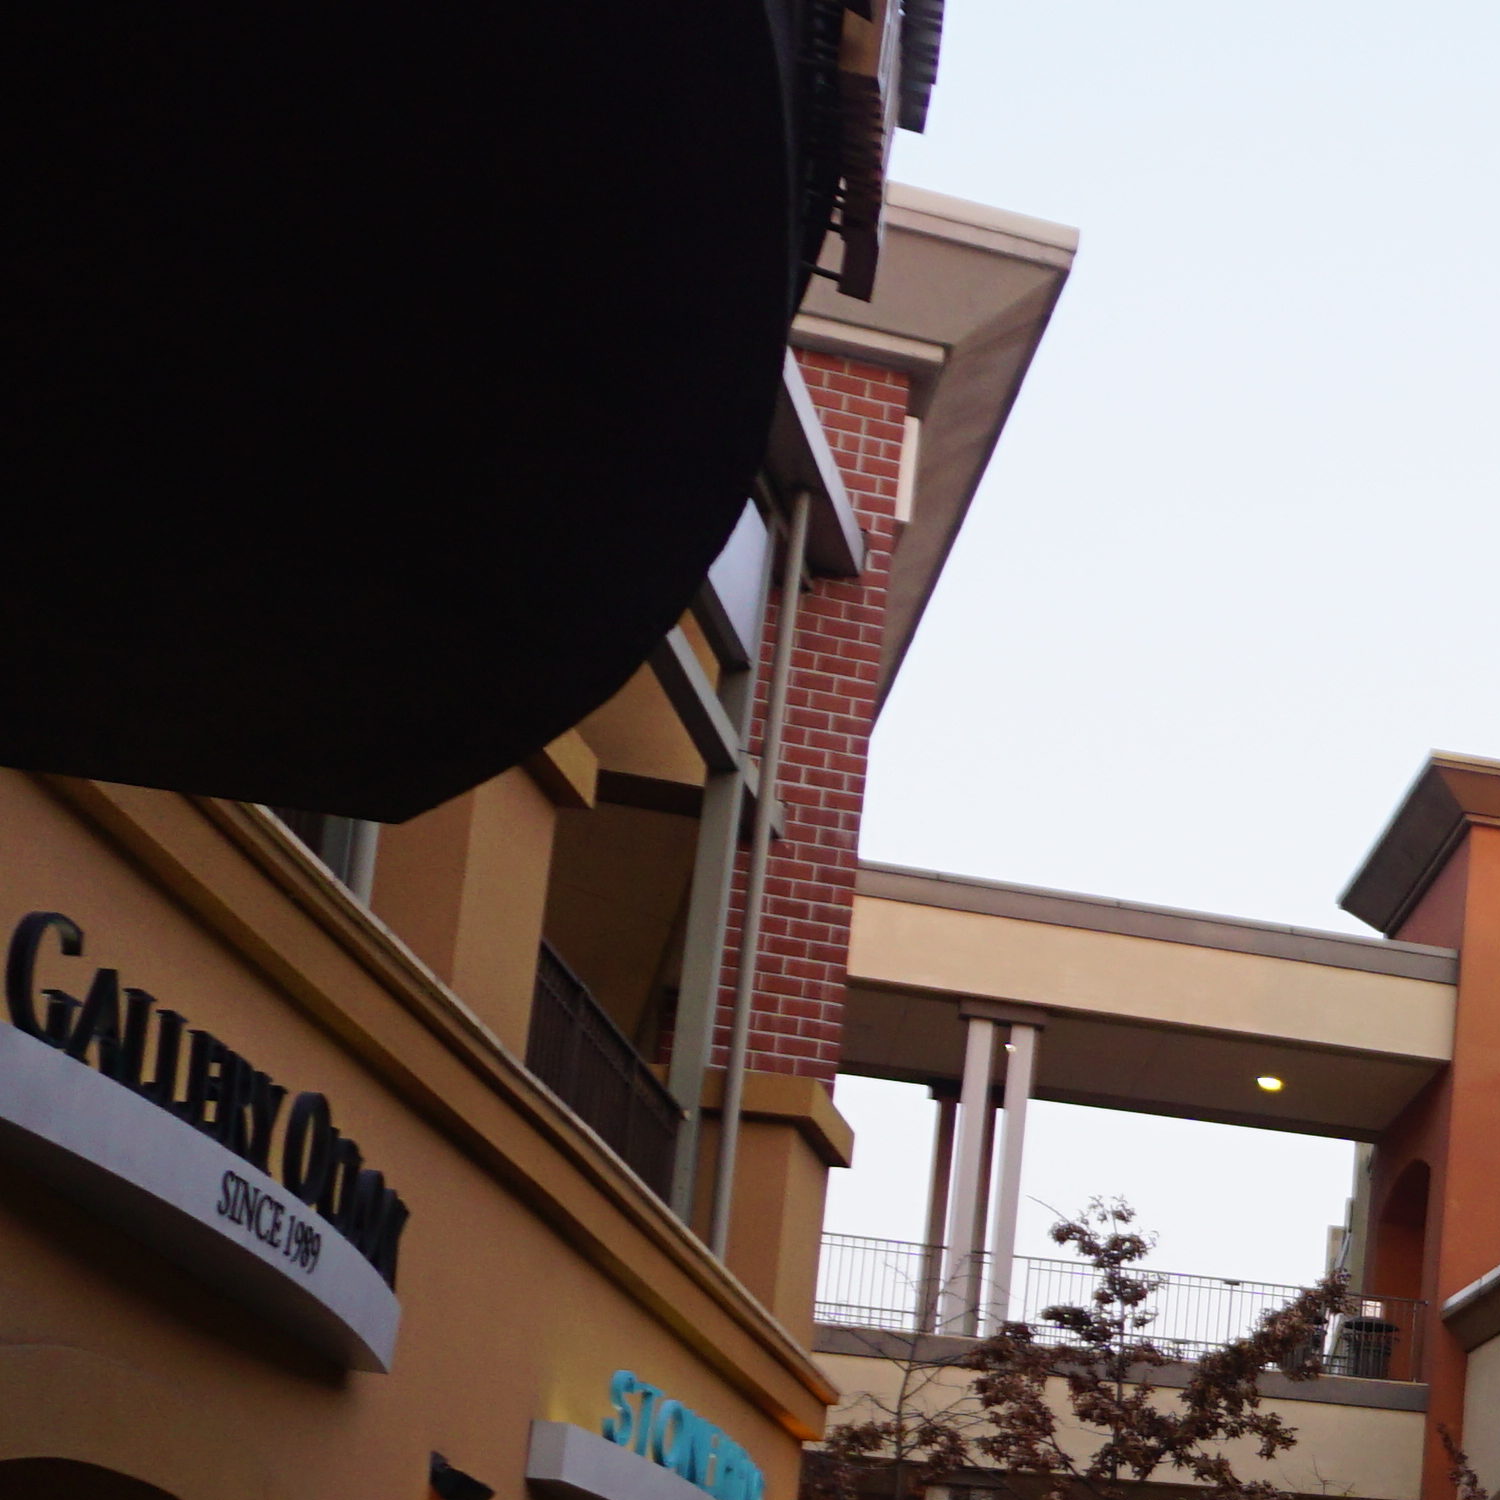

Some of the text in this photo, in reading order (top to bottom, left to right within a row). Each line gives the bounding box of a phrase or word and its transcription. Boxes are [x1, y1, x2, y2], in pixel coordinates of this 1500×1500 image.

[6, 910, 288, 1178] GALLERY
[216, 1170, 322, 1274] SINCE 1989
